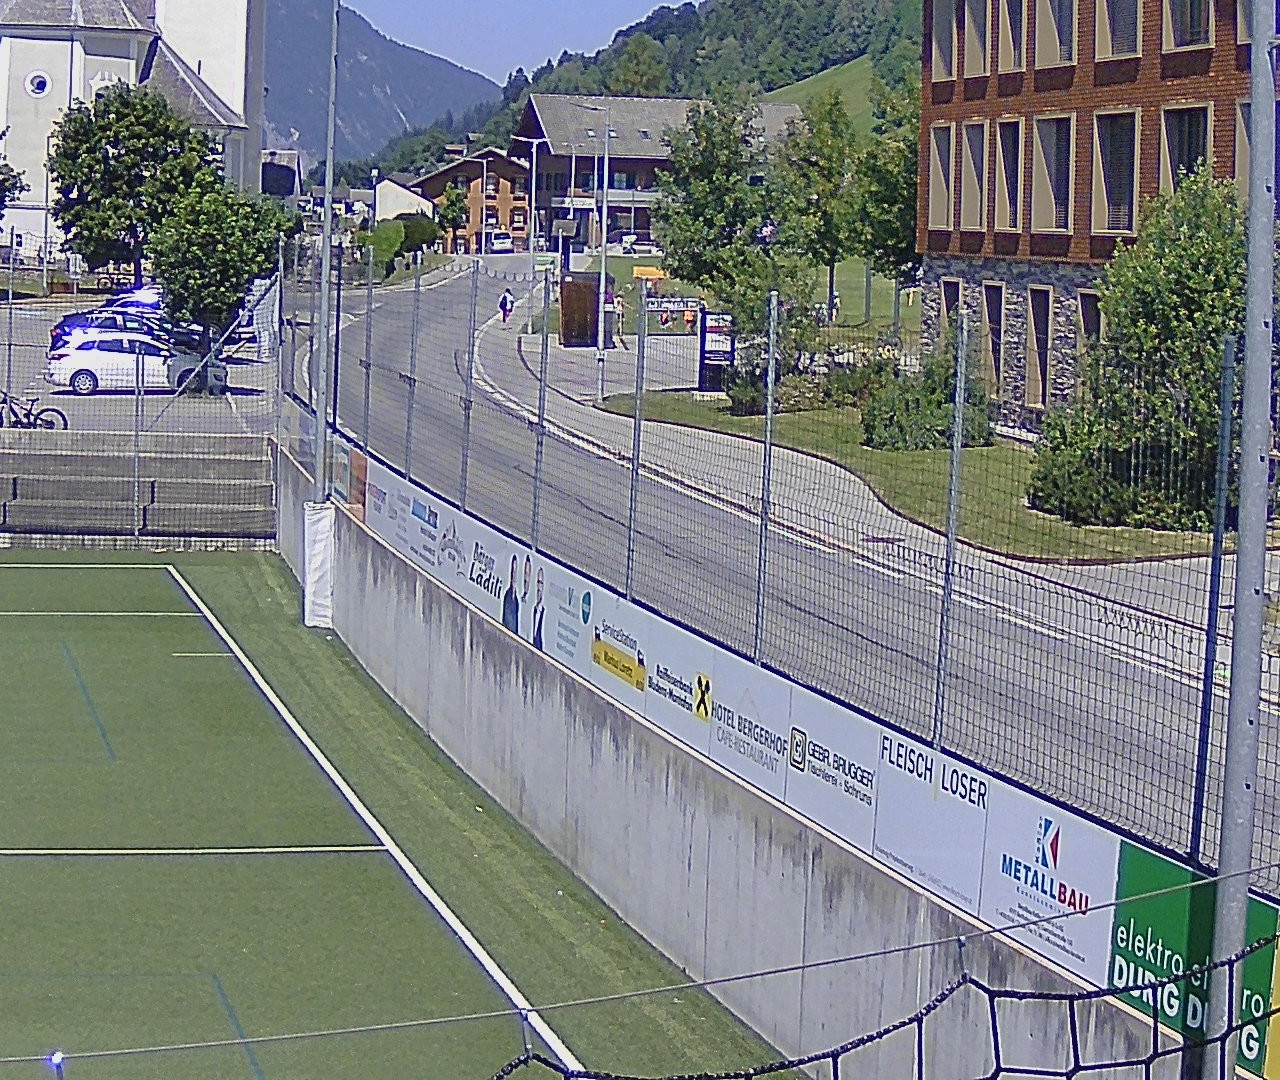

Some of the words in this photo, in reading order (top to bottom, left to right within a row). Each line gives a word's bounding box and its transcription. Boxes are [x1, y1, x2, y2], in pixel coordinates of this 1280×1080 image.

[656, 663, 694, 697] Raiffeisenbank
[711, 700, 736, 730] HOTEL
[737, 715, 789, 757] BERGERHOF
[807, 740, 831, 767] GEBR.
[832, 753, 875, 790] BRUGGER
[881, 734, 934, 784] FLEISCH
[941, 763, 987, 810] LOSER
[1001, 853, 1090, 916] METALLBAU
[1116, 917, 1184, 974] elektro
